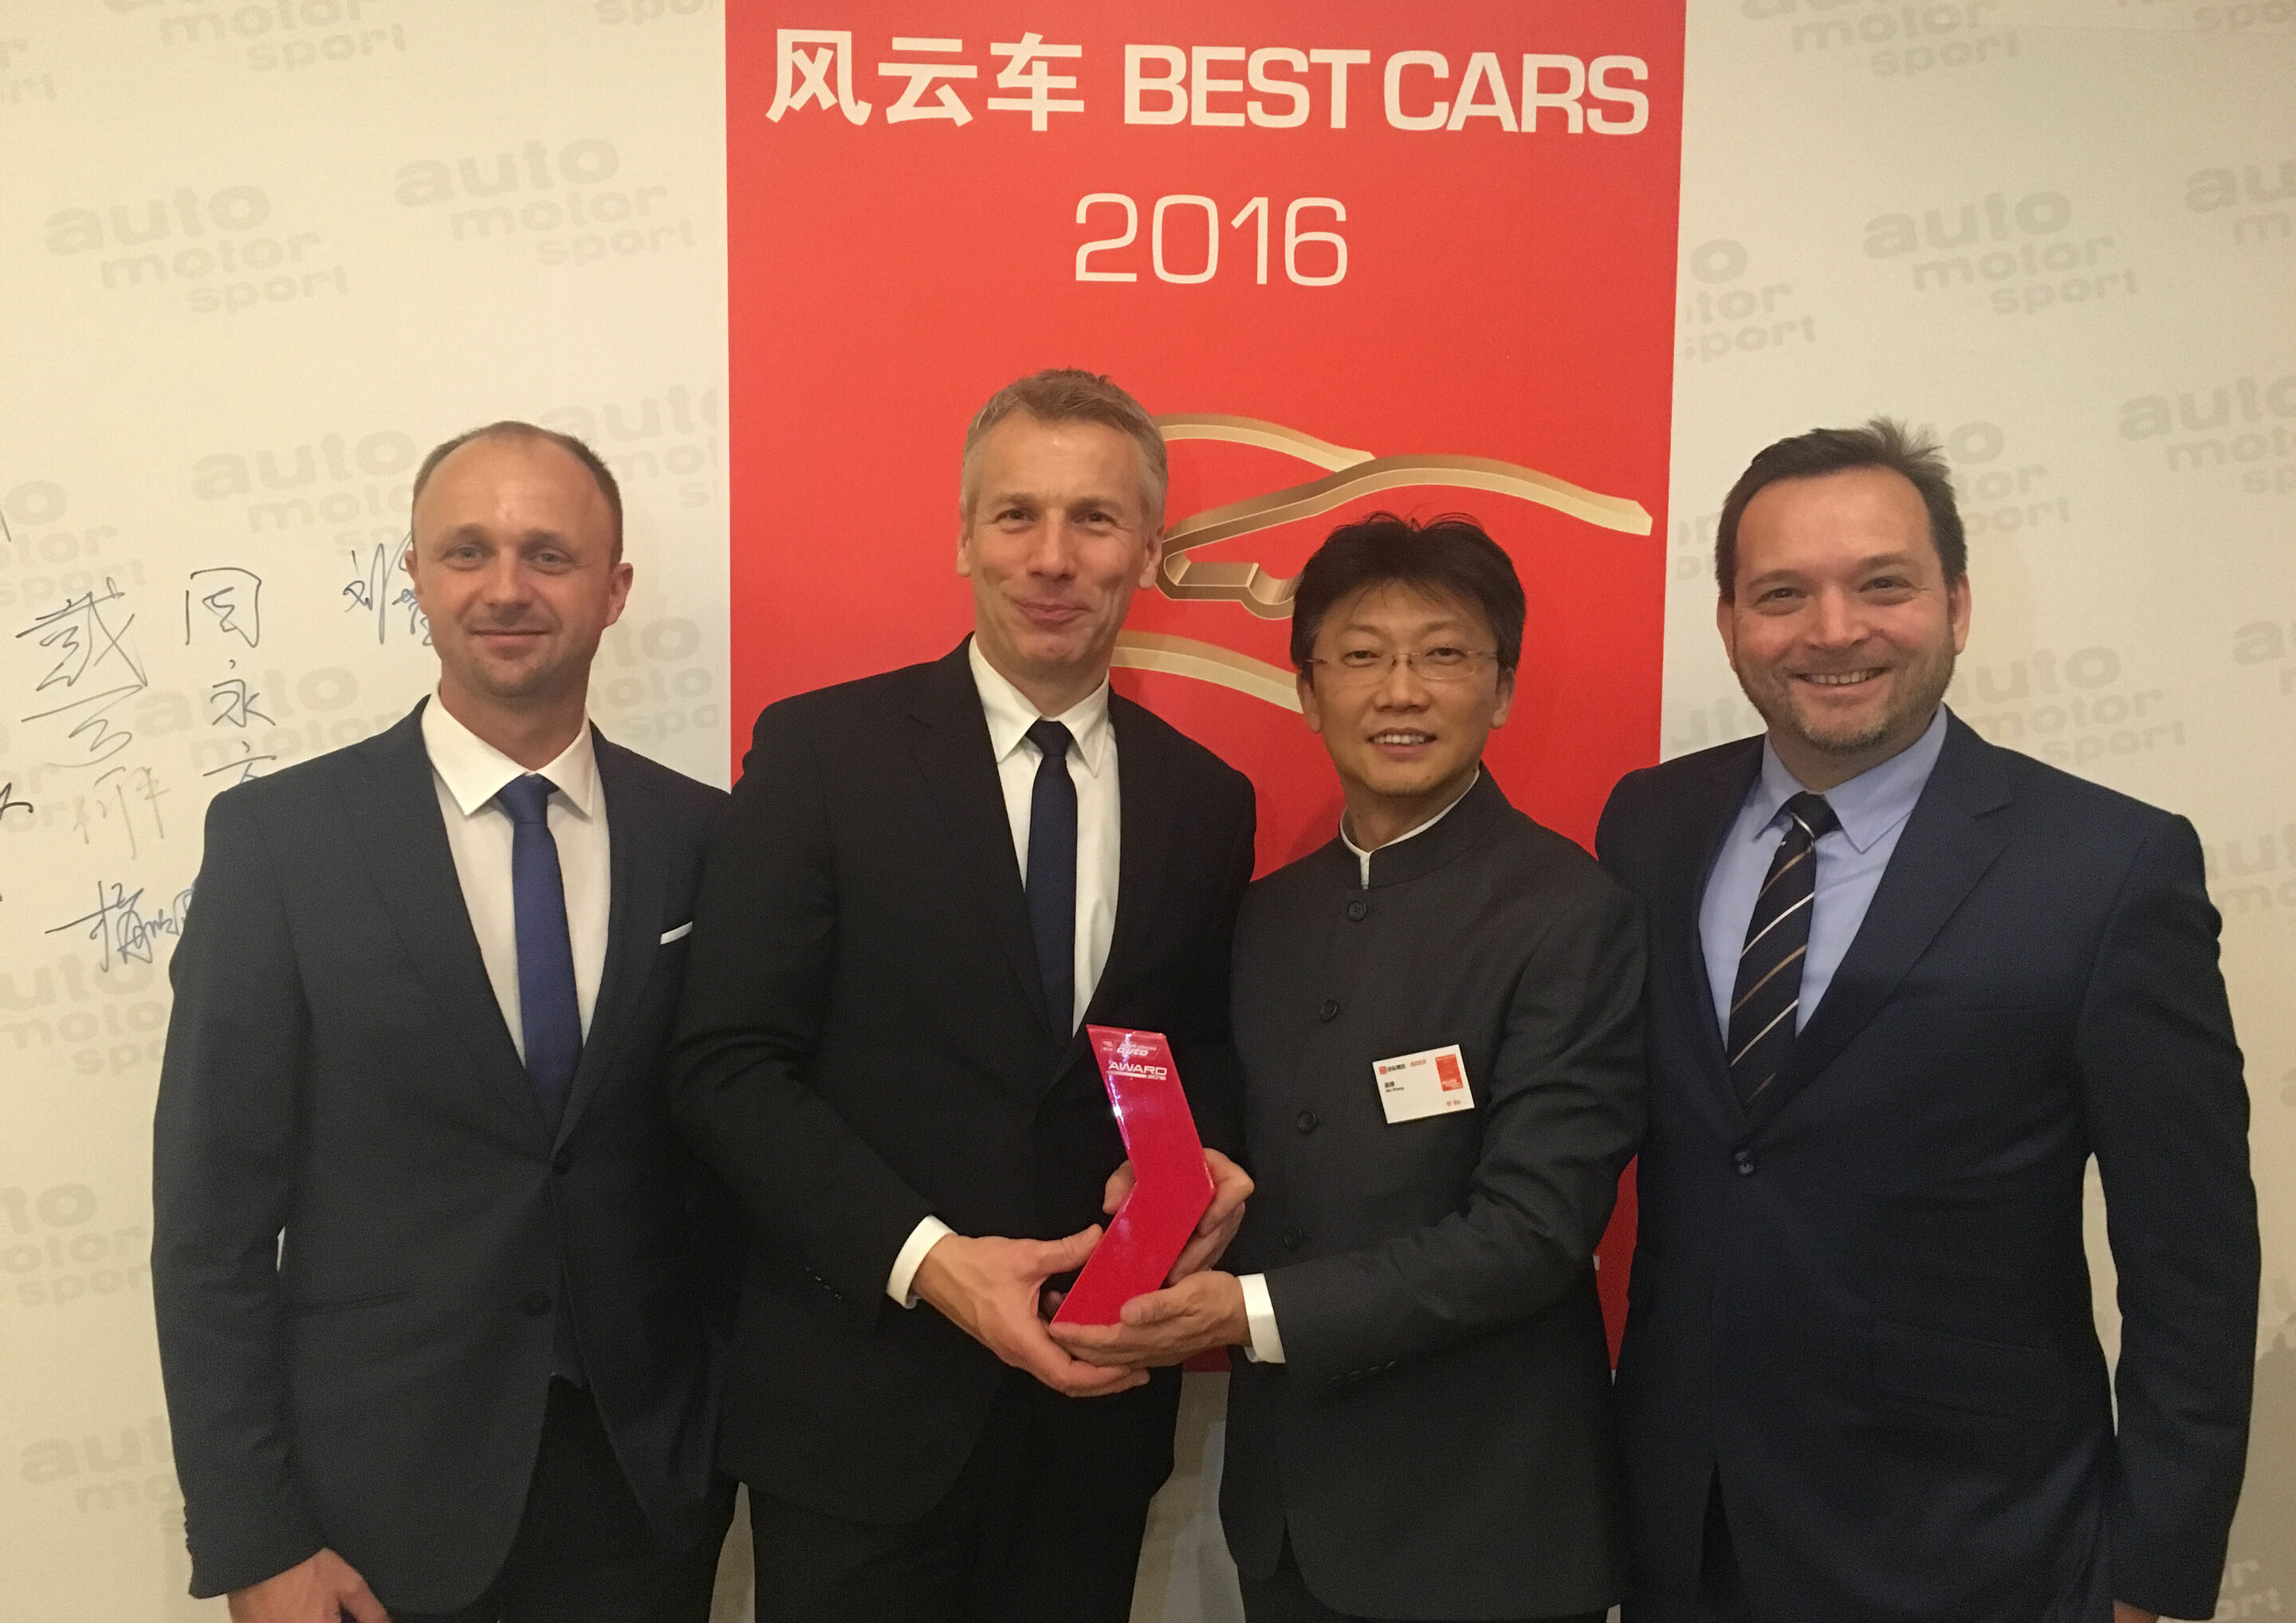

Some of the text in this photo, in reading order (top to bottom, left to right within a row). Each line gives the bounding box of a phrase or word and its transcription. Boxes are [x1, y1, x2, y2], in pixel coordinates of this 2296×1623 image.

[245, 22, 408, 73] sport
[1869, 28, 2021, 77] sport
[765, 29, 1649, 136] 风云车 BEST CARS
[393, 137, 620, 208] auto
[45, 184, 271, 257] auto
[450, 184, 668, 242] motor
[1075, 191, 1349, 288] 2016
[1862, 191, 2072, 260] auto
[100, 230, 322, 292] motor
[536, 218, 697, 268] sport
[1913, 234, 2116, 292] motor
[187, 265, 350, 315] sport
[1991, 268, 2138, 316] sport
[191, 430, 417, 501] auto
[247, 481, 414, 534] moto
[2041, 719, 2187, 767] sport
[1108, 1062, 1167, 1075] AWARD
